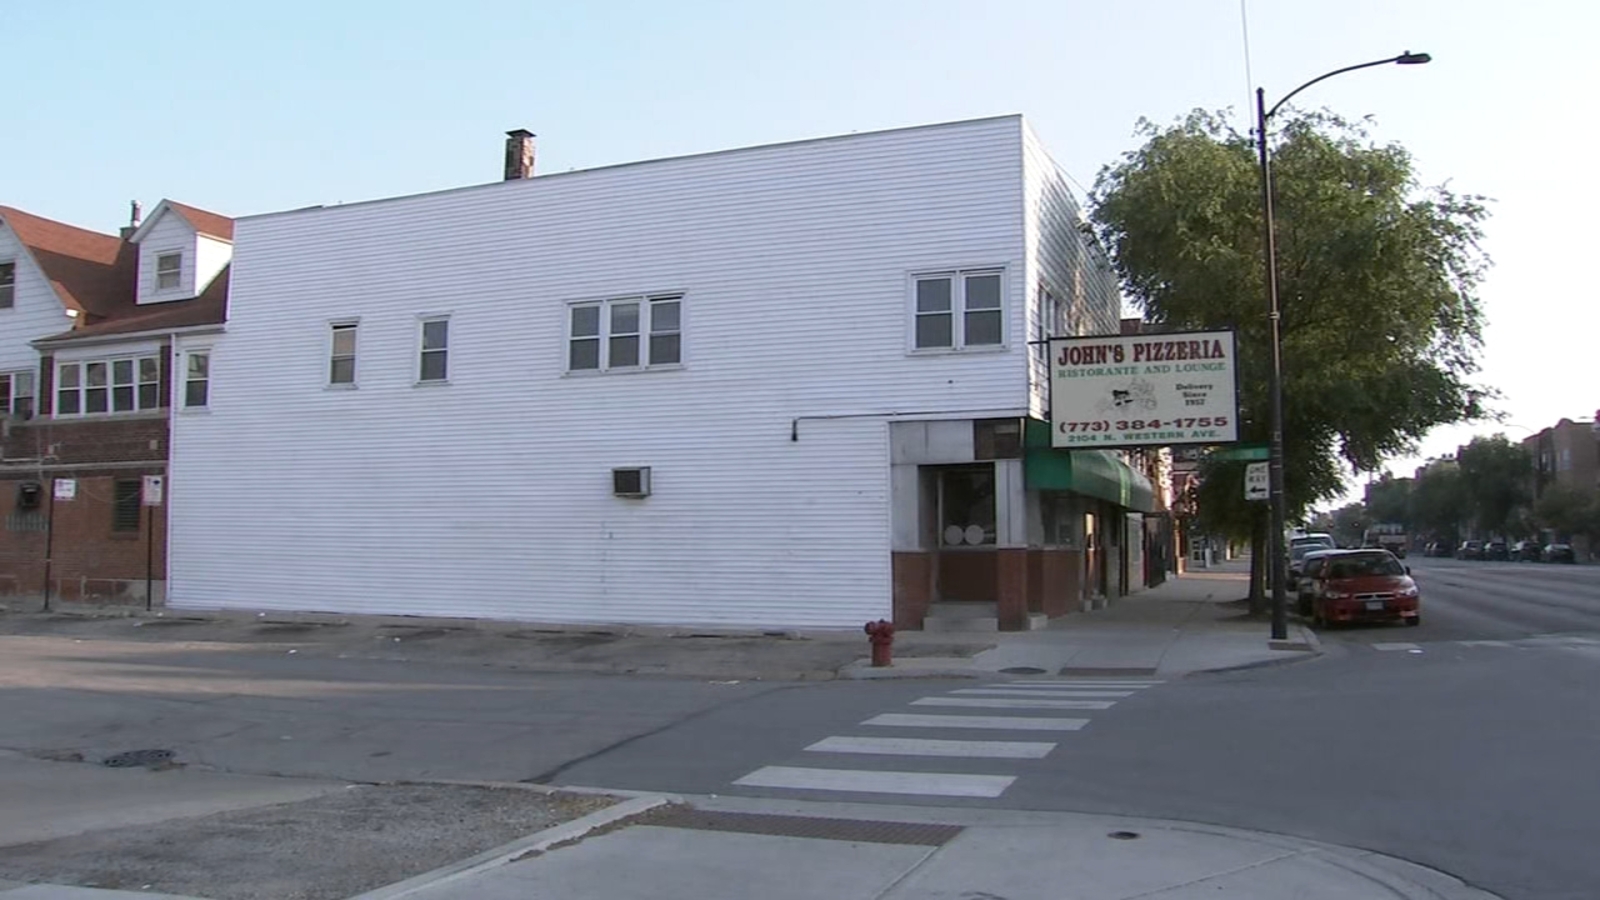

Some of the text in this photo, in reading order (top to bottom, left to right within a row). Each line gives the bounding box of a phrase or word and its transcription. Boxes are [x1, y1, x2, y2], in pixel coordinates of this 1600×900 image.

[1058, 339, 1225, 366] JOHN'S PIZZERIA
[1058, 362, 1226, 378] RISTORANTE AND LOUNGE
[1175, 383, 1213, 391] Delivery
[1059, 416, 1228, 434] (773) 384-1755
[1068, 429, 1221, 442] 2104 N. WESTERN AVE.
